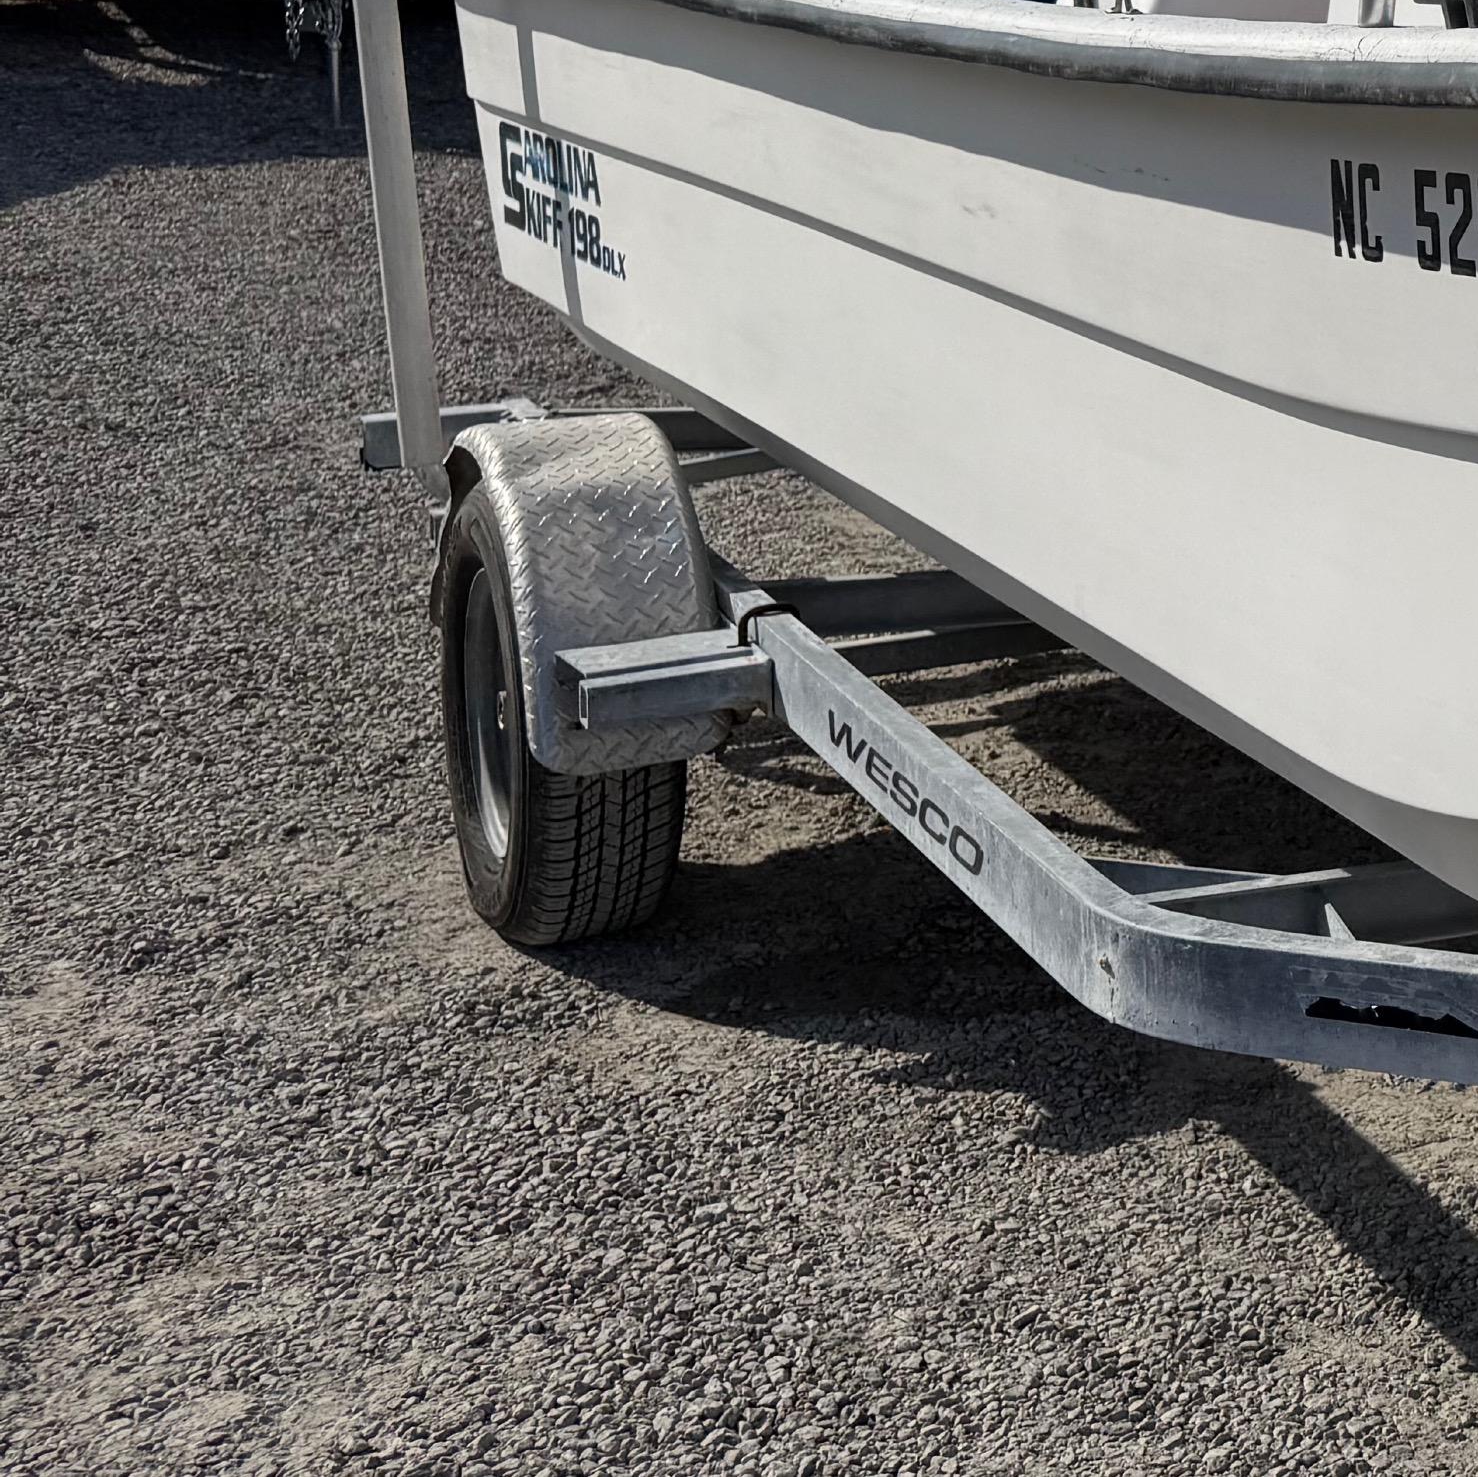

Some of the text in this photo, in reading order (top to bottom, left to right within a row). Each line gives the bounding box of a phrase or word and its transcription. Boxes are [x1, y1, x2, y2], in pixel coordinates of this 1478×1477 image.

[499, 121, 602, 208] CAROLINA
[503, 151, 563, 249] SKIFF
[1330, 158, 1384, 263] NC
[827, 708, 985, 877] WESCO
